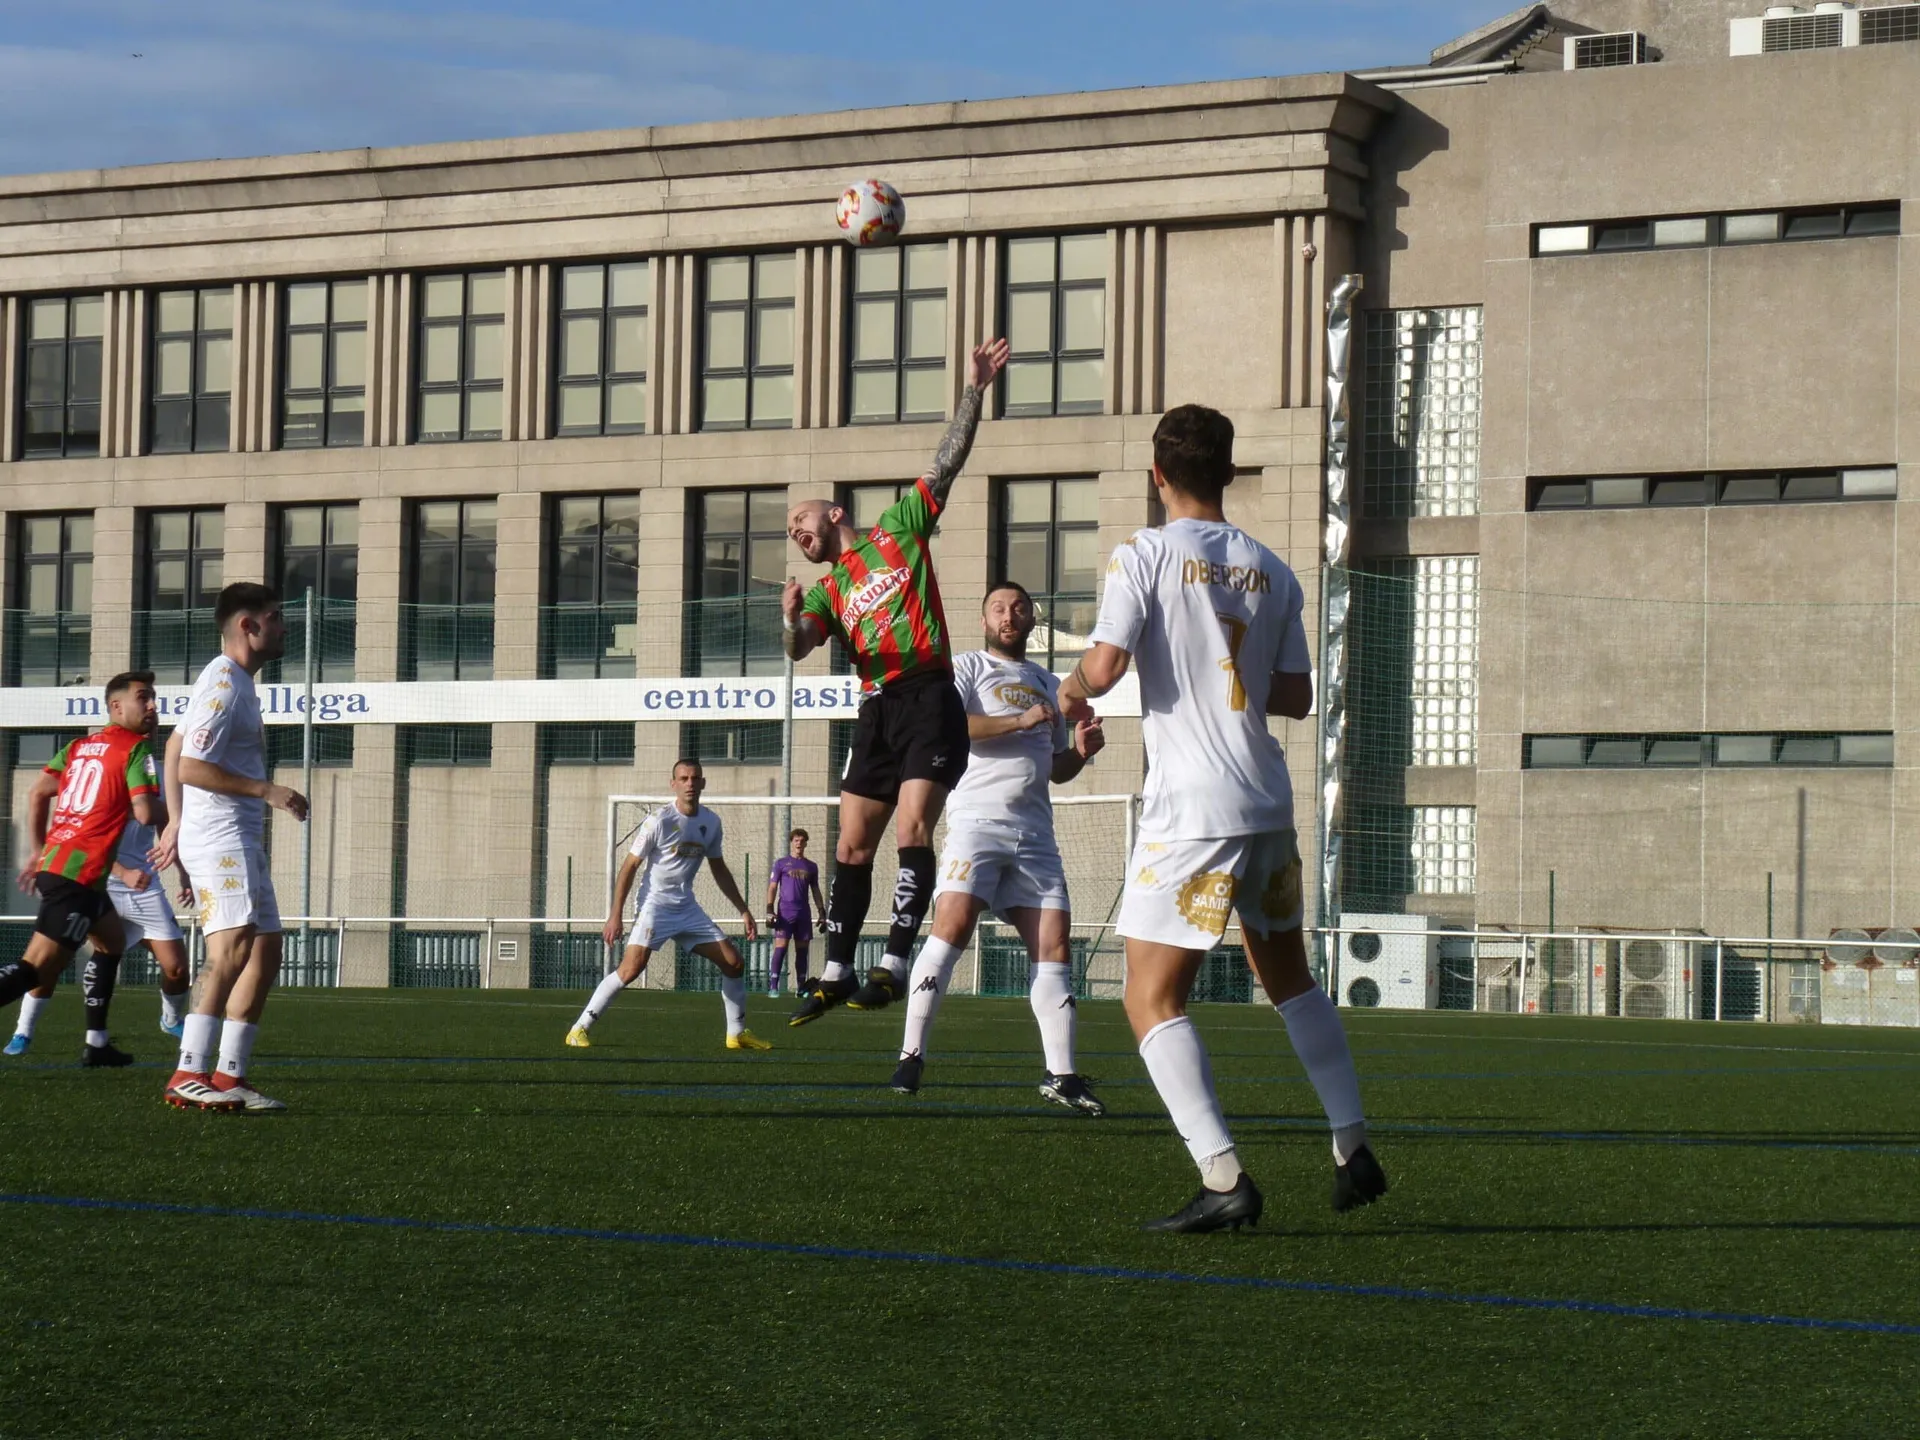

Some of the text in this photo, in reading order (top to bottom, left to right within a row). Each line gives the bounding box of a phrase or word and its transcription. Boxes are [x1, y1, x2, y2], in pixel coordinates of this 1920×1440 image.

[842, 567, 909, 630] PRÉSIDENT
[1215, 612, 1249, 713] 7
[257, 687, 370, 721] llega
[644, 680, 863, 710] centro asi
[56, 757, 104, 816] 10
[946, 859, 972, 882] 22
[61, 911, 92, 943] 10
